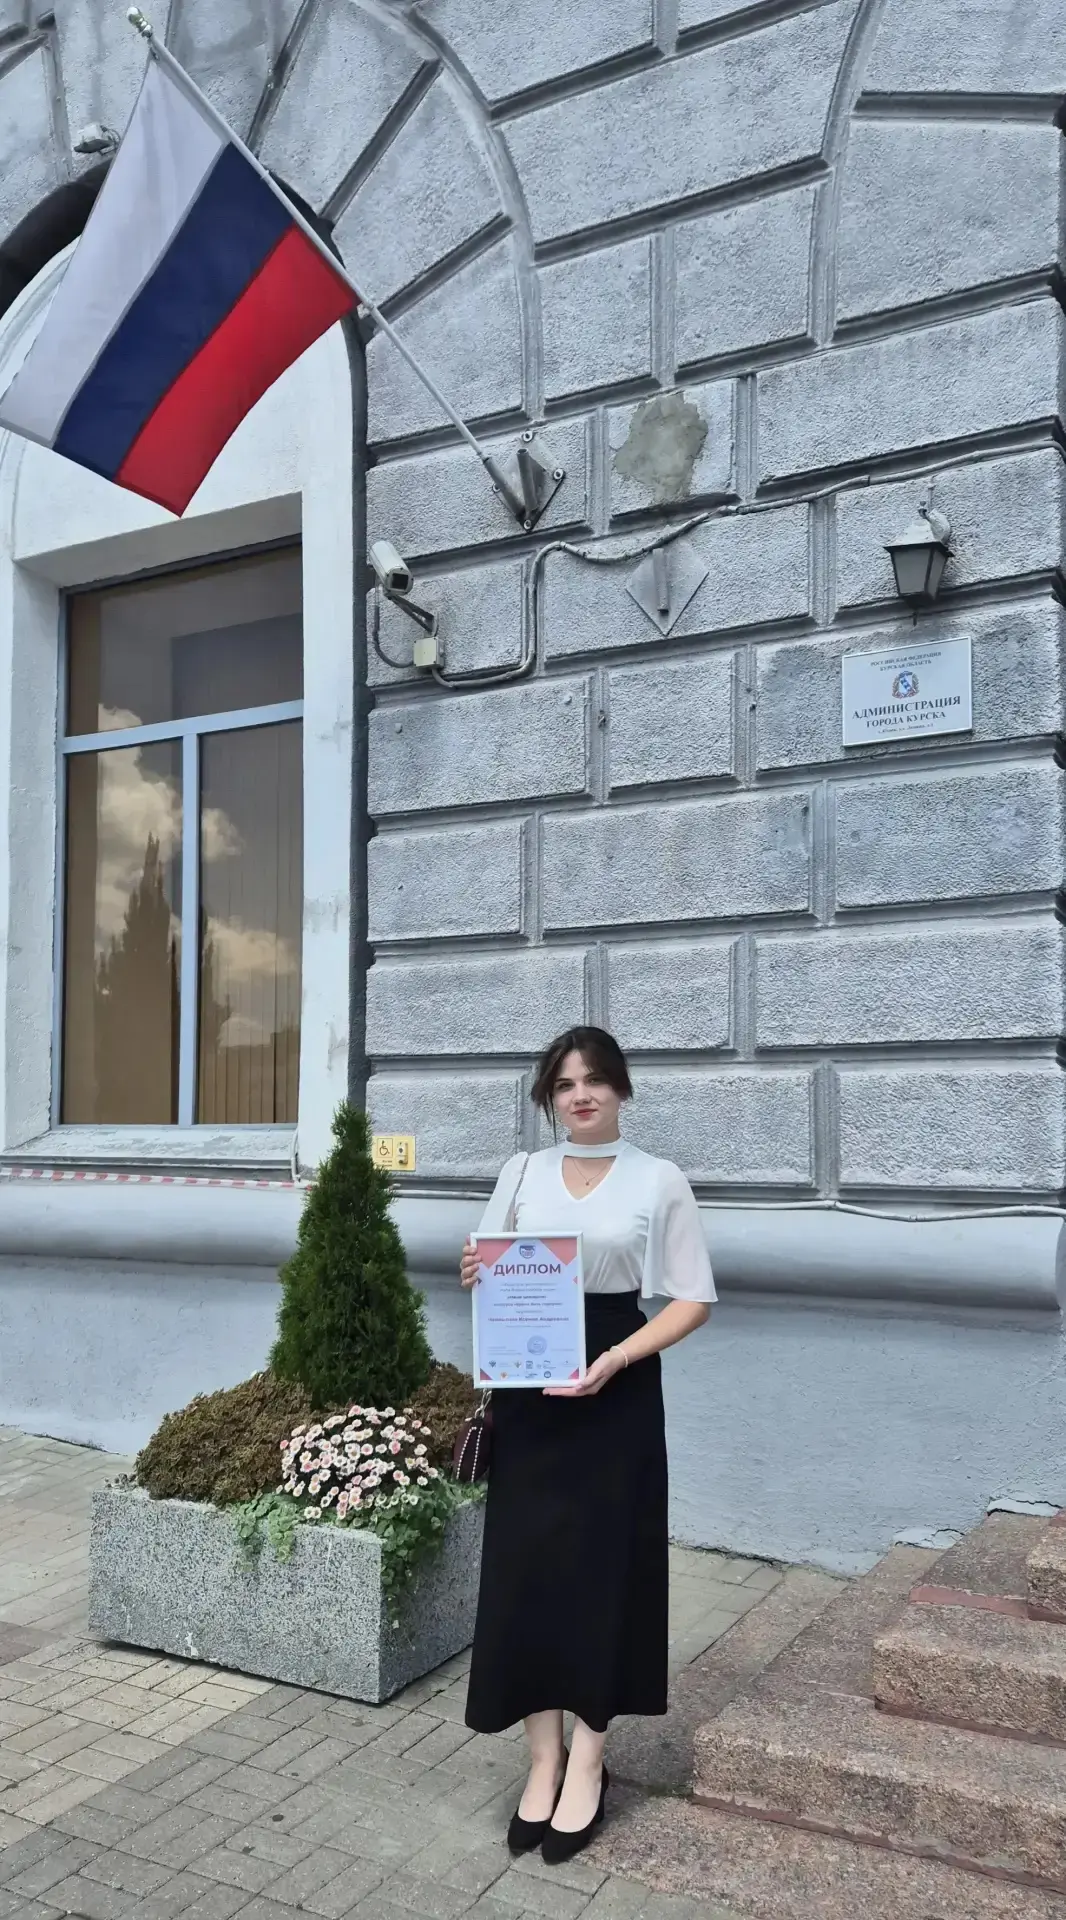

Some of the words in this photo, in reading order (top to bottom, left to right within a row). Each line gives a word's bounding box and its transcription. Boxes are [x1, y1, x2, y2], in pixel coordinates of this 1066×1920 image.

[880, 663, 905, 671] КУРСКАЯ
[852, 696, 961, 719] АДМИНИСТРАЦИЯ
[866, 715, 904, 728] ГОРОДА
[906, 711, 946, 723] КУРСКА
[493, 1263, 561, 1276] ДИПЛОМ
